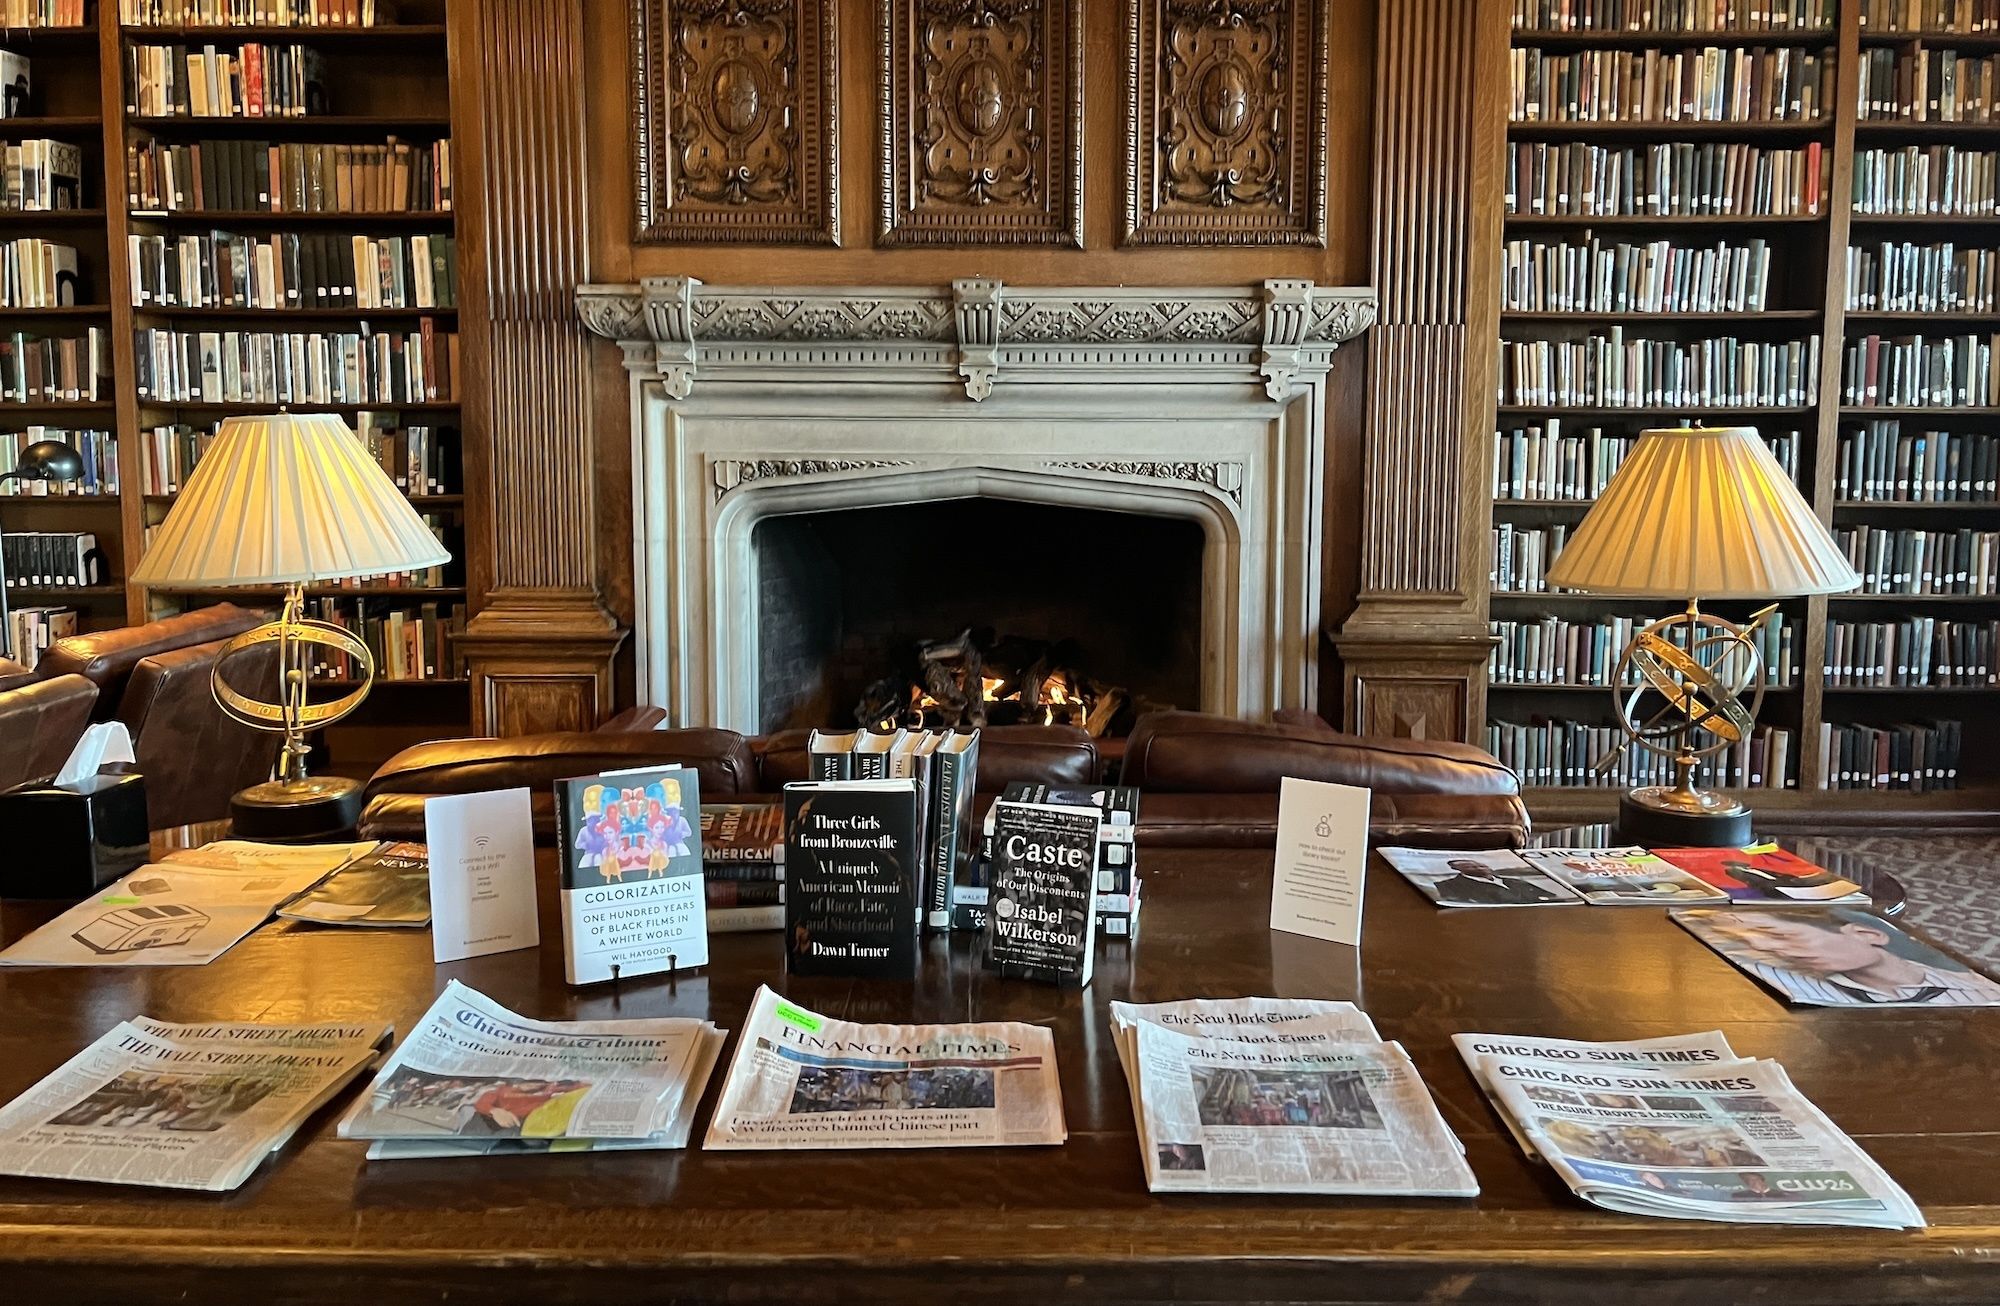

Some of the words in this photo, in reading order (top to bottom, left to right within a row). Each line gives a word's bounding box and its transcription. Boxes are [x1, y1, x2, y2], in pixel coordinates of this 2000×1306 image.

[939, 759, 953, 818] PARADISE
[813, 814, 849, 829] Three
[851, 815, 881, 830] Girls
[800, 833, 829, 848] from
[831, 834, 898, 849] Bronzeville
[702, 847, 772, 860] AMERICAN
[1006, 835, 1083, 868] Caste
[1522, 849, 1649, 859] CHICAGO
[374, 858, 418, 868] NEW
[828, 860, 880, 877] Uniquely
[1014, 867, 1033, 878] The
[1034, 870, 1071, 884] Origins
[584, 881, 691, 904] COLORIZATION
[797, 878, 854, 893] American
[856, 879, 900, 894] Memoir
[935, 873, 946, 912] MORRIS
[996, 878, 1009, 889] of
[1008, 879, 1028, 891] Our
[1029, 882, 1086, 900] Discontents
[583, 913, 606, 924] ONE
[609, 906, 661, 920] HUNDRED
[664, 901, 695, 913] YEARS
[1013, 903, 1063, 925] Isabel
[591, 925, 606, 935] OF
[608, 921, 643, 933] BLACK
[646, 916, 675, 928] FILMS
[678, 914, 689, 923] IN
[996, 920, 1077, 947] Wilkerson
[599, 939, 606, 947] A
[609, 933, 643, 945] WHITE
[645, 928, 683, 940] WORLD
[611, 953, 627, 961] WIL
[629, 946, 672, 959] HAYGOOD
[812, 941, 847, 957] Dawn
[848, 942, 890, 957] Turner
[454, 1008, 542, 1045] Chicago
[576, 1037, 667, 1048] Tribune
[1161, 1013, 1190, 1025] The
[1193, 1014, 1225, 1025] New
[1227, 1013, 1266, 1025] York
[144, 1024, 177, 1038] THE
[178, 1028, 223, 1039] WALL
[225, 1028, 294, 1039] STREET
[293, 1028, 365, 1040] JOURNAL
[430, 1023, 458, 1042] Tax
[458, 1040, 521, 1057] official's
[782, 1025, 922, 1056] FINANCIAL
[941, 1042, 1022, 1053] TIMES
[1278, 1033, 1327, 1044] Times
[118, 1034, 159, 1057] THE
[157, 1049, 202, 1063] WALL
[200, 1051, 269, 1065] STREET
[269, 1054, 344, 1067] JOURNAL
[1187, 1047, 1217, 1059] The
[1221, 1050, 1256, 1061] New
[1260, 1053, 1301, 1065] York
[1302, 1053, 1355, 1063] Times
[1473, 1043, 1582, 1061] CHICAGO
[1586, 1049, 1721, 1063] SUN-TIMES
[1498, 1064, 1612, 1089] CHICAGO
[1617, 1077, 1757, 1092] SUN-TIMES
[820, 1114, 852, 1123] held
[896, 1114, 934, 1124] ports
[1534, 1101, 1595, 1117] TREASURE
[1596, 1107, 1645, 1119] TROVE'S
[1648, 1111, 1681, 1120] LAST
[1680, 1111, 1712, 1120] DAYS
[760, 1123, 829, 1133] discovers
[832, 1121, 886, 1132] banned
[889, 1121, 947, 1132] Chinese
[950, 1121, 981, 1133] part
